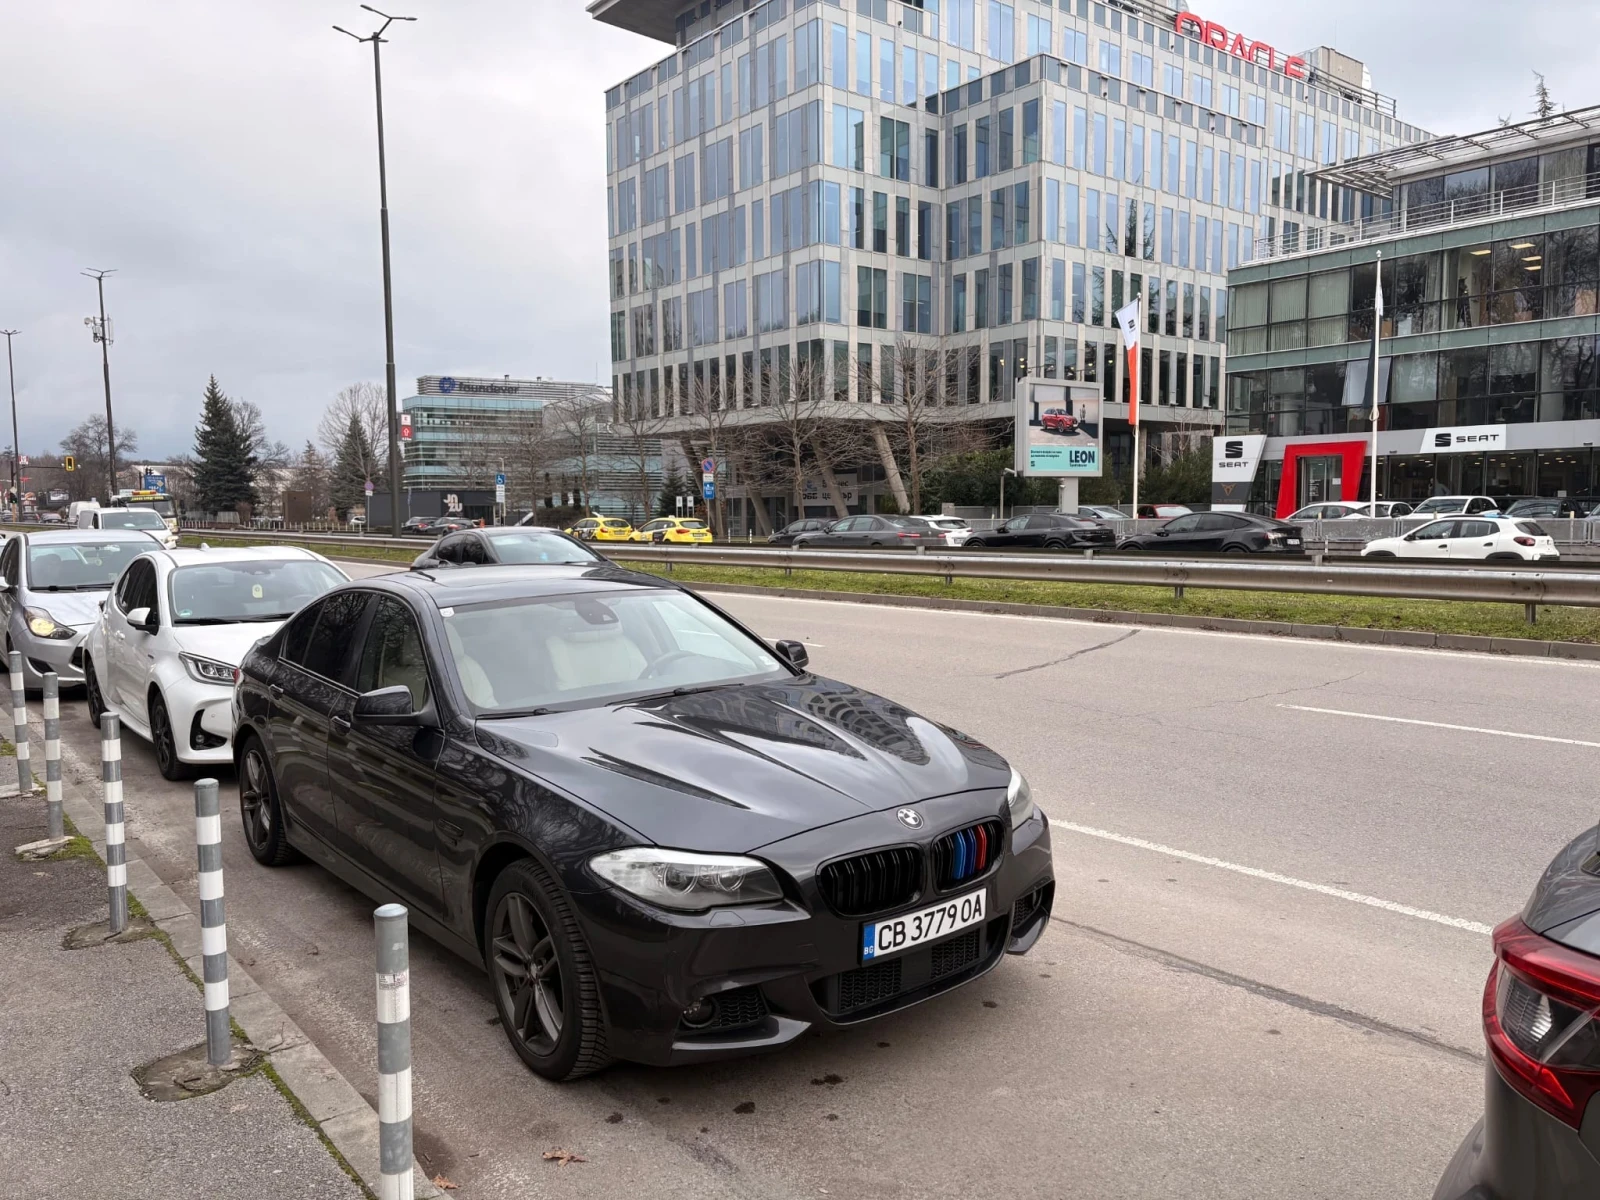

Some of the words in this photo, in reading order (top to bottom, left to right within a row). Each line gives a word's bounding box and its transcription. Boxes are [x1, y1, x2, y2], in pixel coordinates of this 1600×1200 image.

[1175, 11, 1306, 78] ORACLE
[1456, 434, 1499, 443] SEAT
[1069, 450, 1096, 463] LEON
[878, 920, 906, 950] CB
[911, 904, 957, 941] 3779
[863, 945, 874, 955] BG
